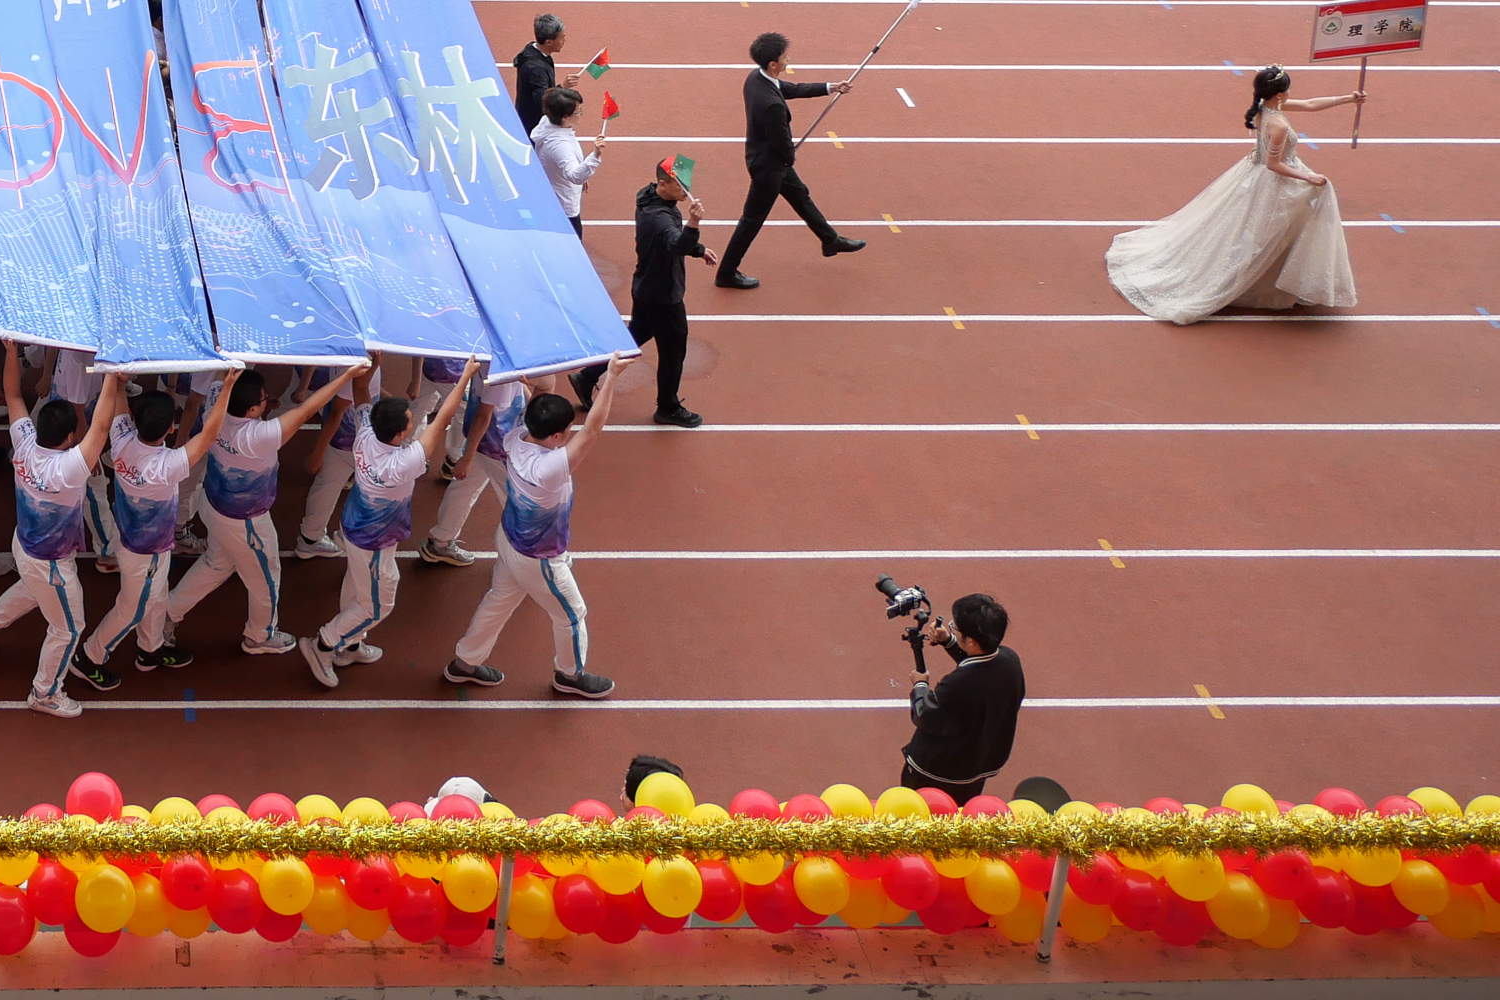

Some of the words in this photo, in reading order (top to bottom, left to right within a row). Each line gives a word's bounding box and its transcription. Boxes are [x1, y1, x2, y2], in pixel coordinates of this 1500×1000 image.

[1348, 17, 1414, 37] 理学院
[285, 43, 531, 205] 东林
